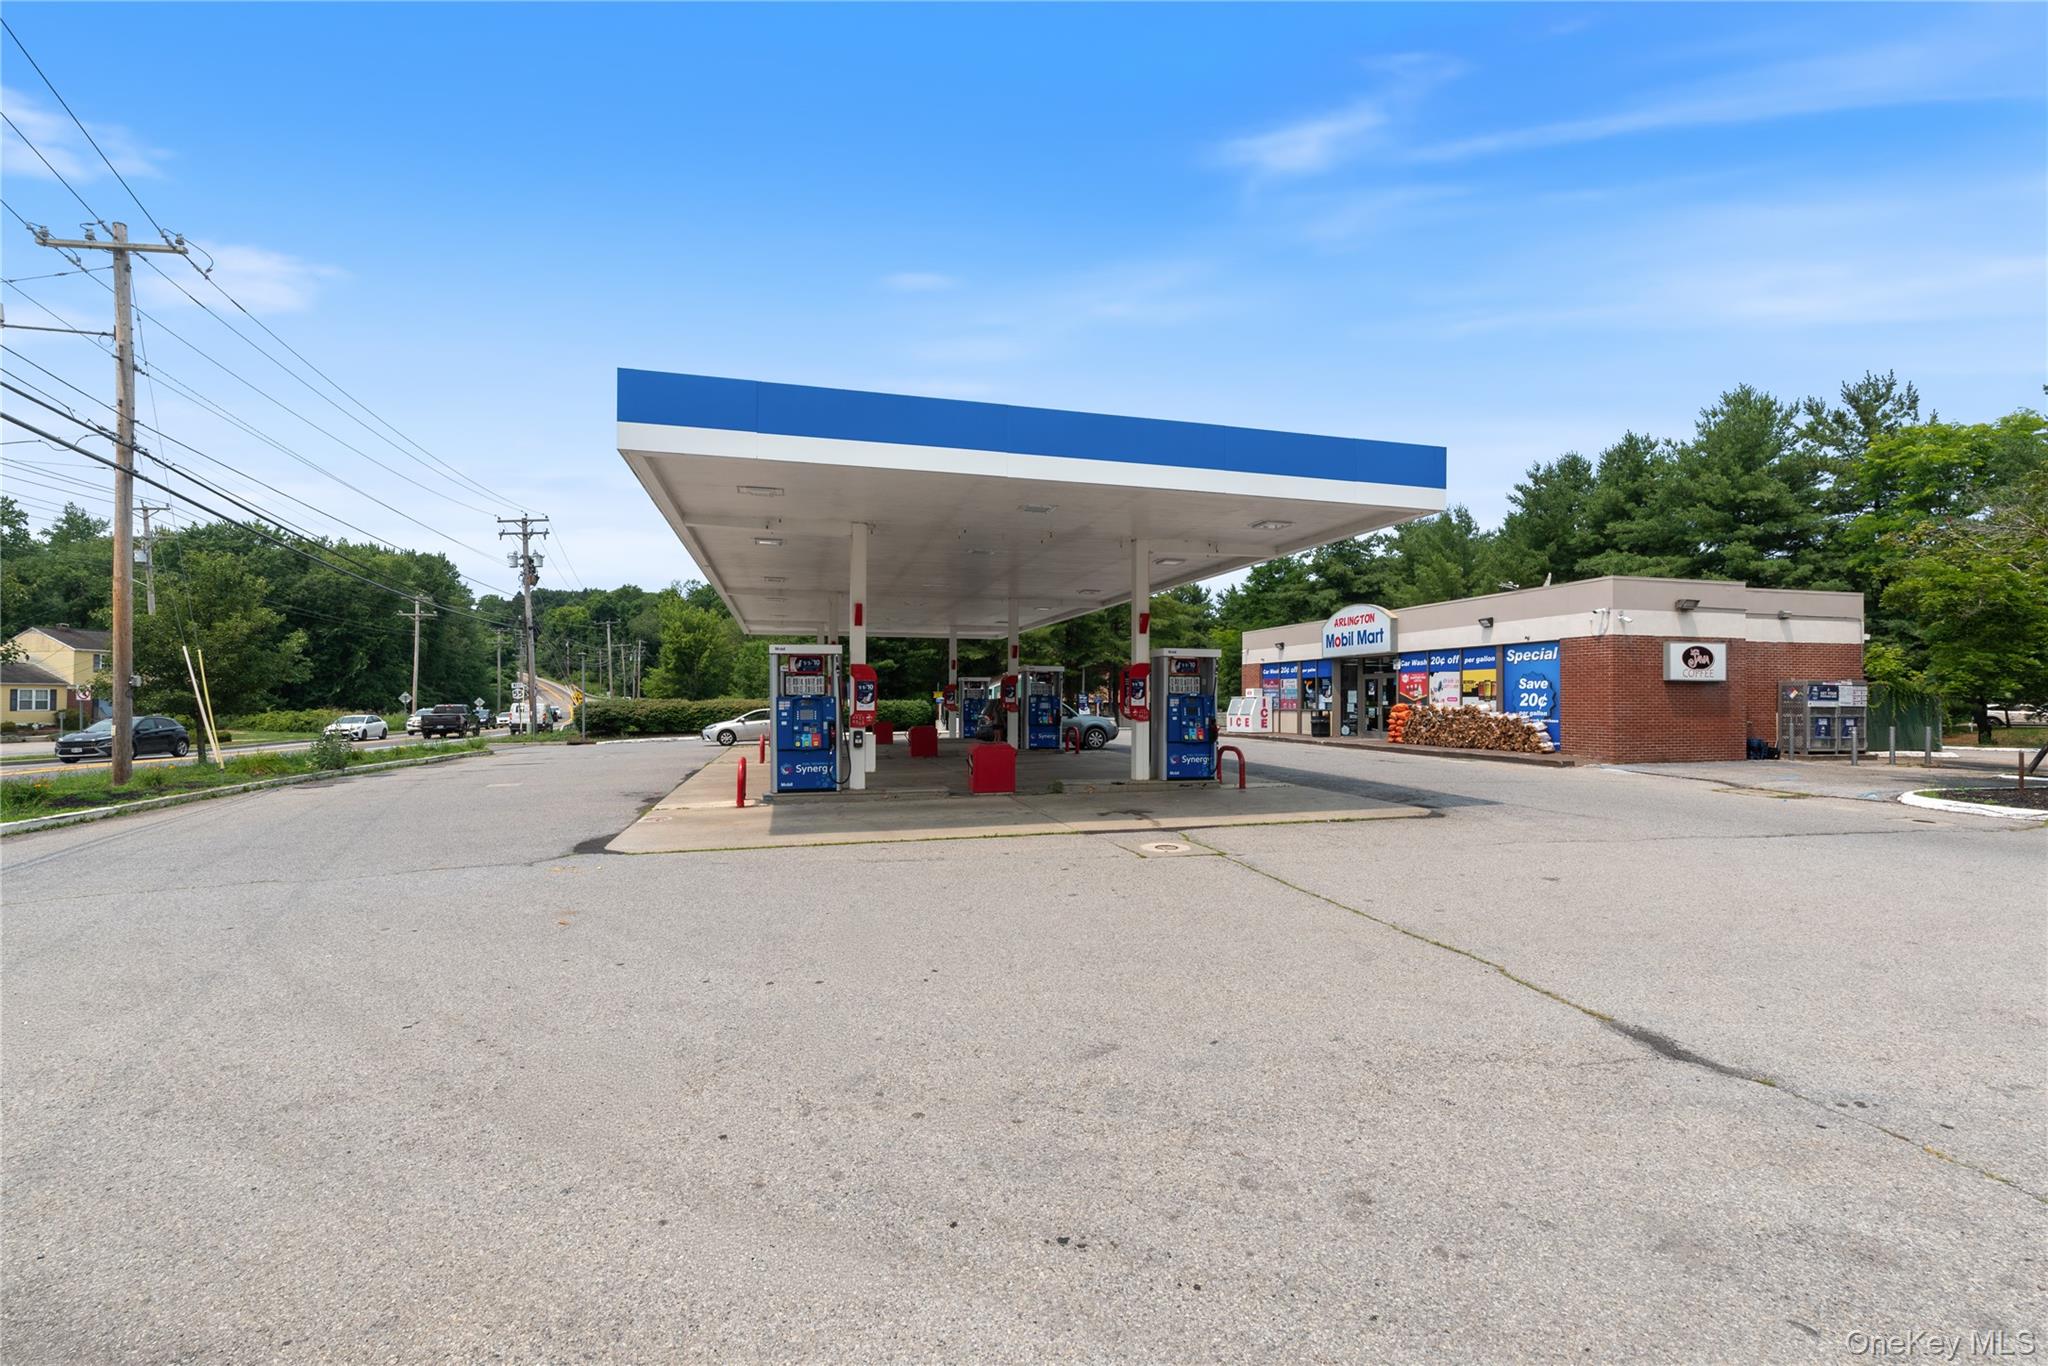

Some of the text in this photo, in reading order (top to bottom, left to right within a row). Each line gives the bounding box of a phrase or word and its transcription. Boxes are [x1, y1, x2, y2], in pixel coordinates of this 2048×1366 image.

[1334, 612, 1376, 628] ARLINGTON
[1325, 627, 1384, 649] Mobil Mart
[1430, 654, 1460, 666] 20¢ off
[1475, 655, 1496, 664] gallon
[1506, 646, 1558, 665] Special
[1411, 658, 1428, 667] Wash
[1682, 669, 1714, 678] COFFEE
[1518, 677, 1549, 690] Save
[1519, 692, 1548, 709] 20¢
[1260, 698, 1268, 729] ICE
[1230, 717, 1250, 727] ICE
